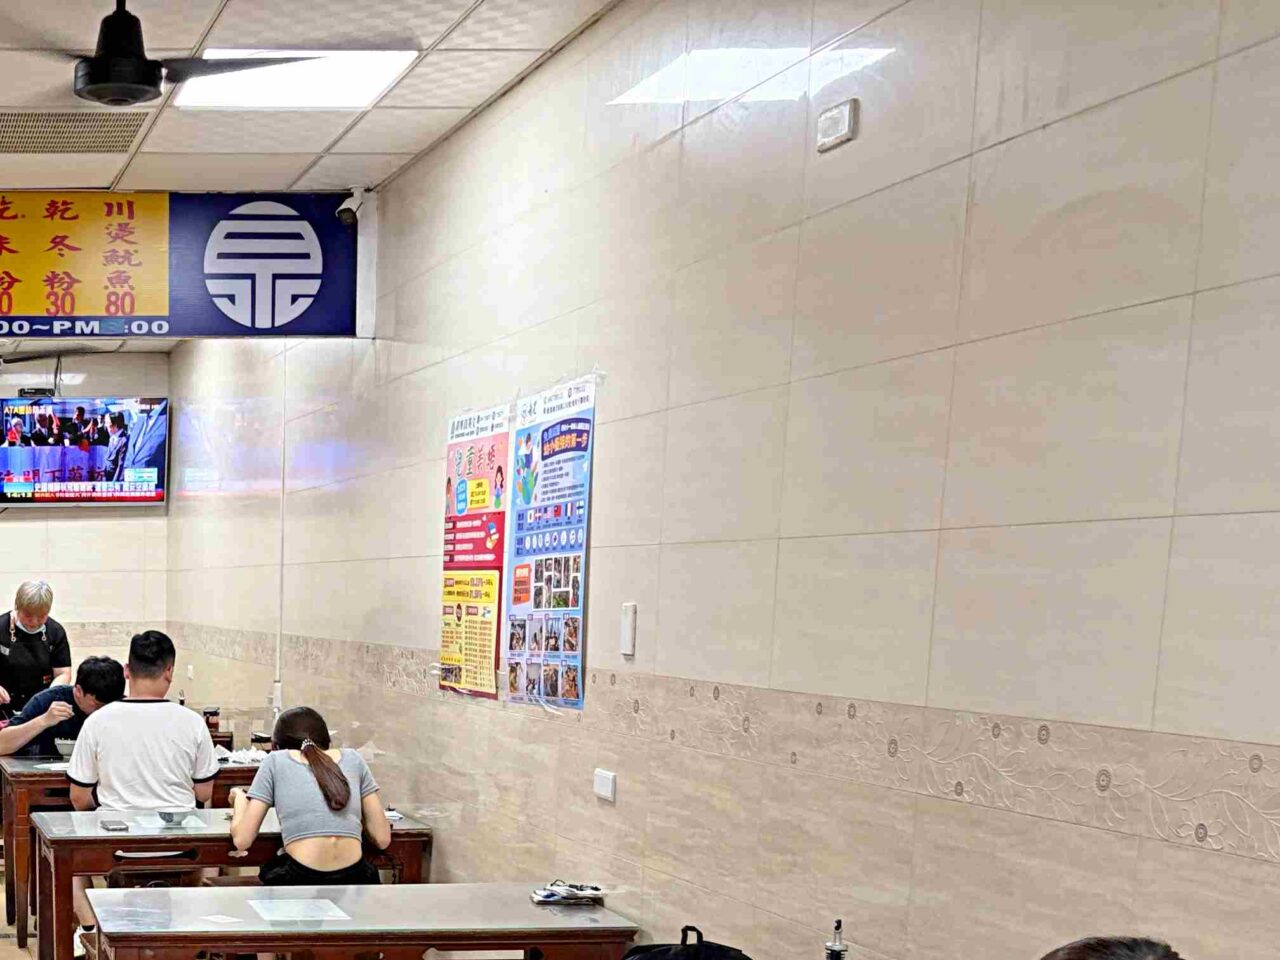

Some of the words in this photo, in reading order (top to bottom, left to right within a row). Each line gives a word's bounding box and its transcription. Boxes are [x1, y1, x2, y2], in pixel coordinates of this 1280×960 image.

[42, 199, 82, 291] 乾冬粉
[45, 290, 75, 316] 30
[104, 290, 135, 316] 80
